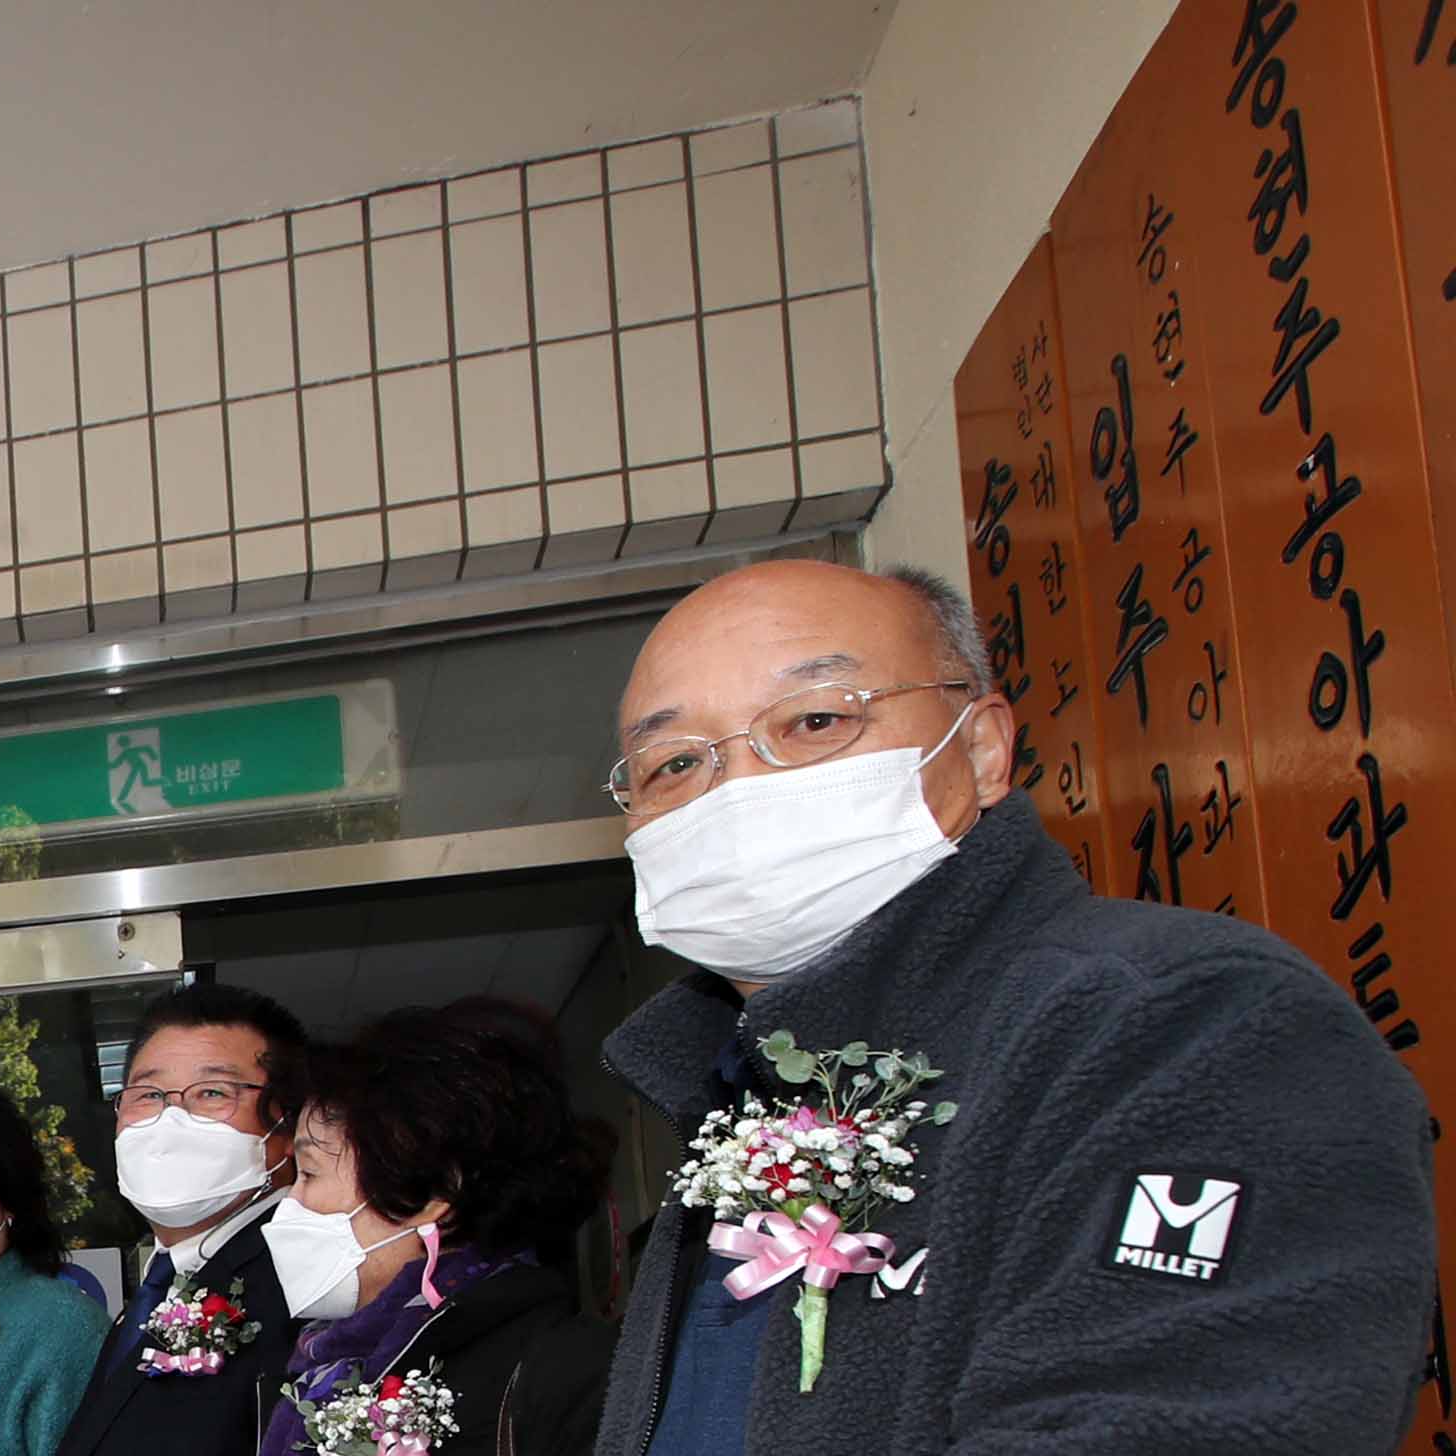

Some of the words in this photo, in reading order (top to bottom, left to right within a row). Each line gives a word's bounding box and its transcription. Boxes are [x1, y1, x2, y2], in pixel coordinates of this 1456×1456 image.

[1136, 192, 1243, 915] 송현주공아파
[175, 759, 241, 783] 비상문
[1114, 1244, 1220, 1281] MILLET
